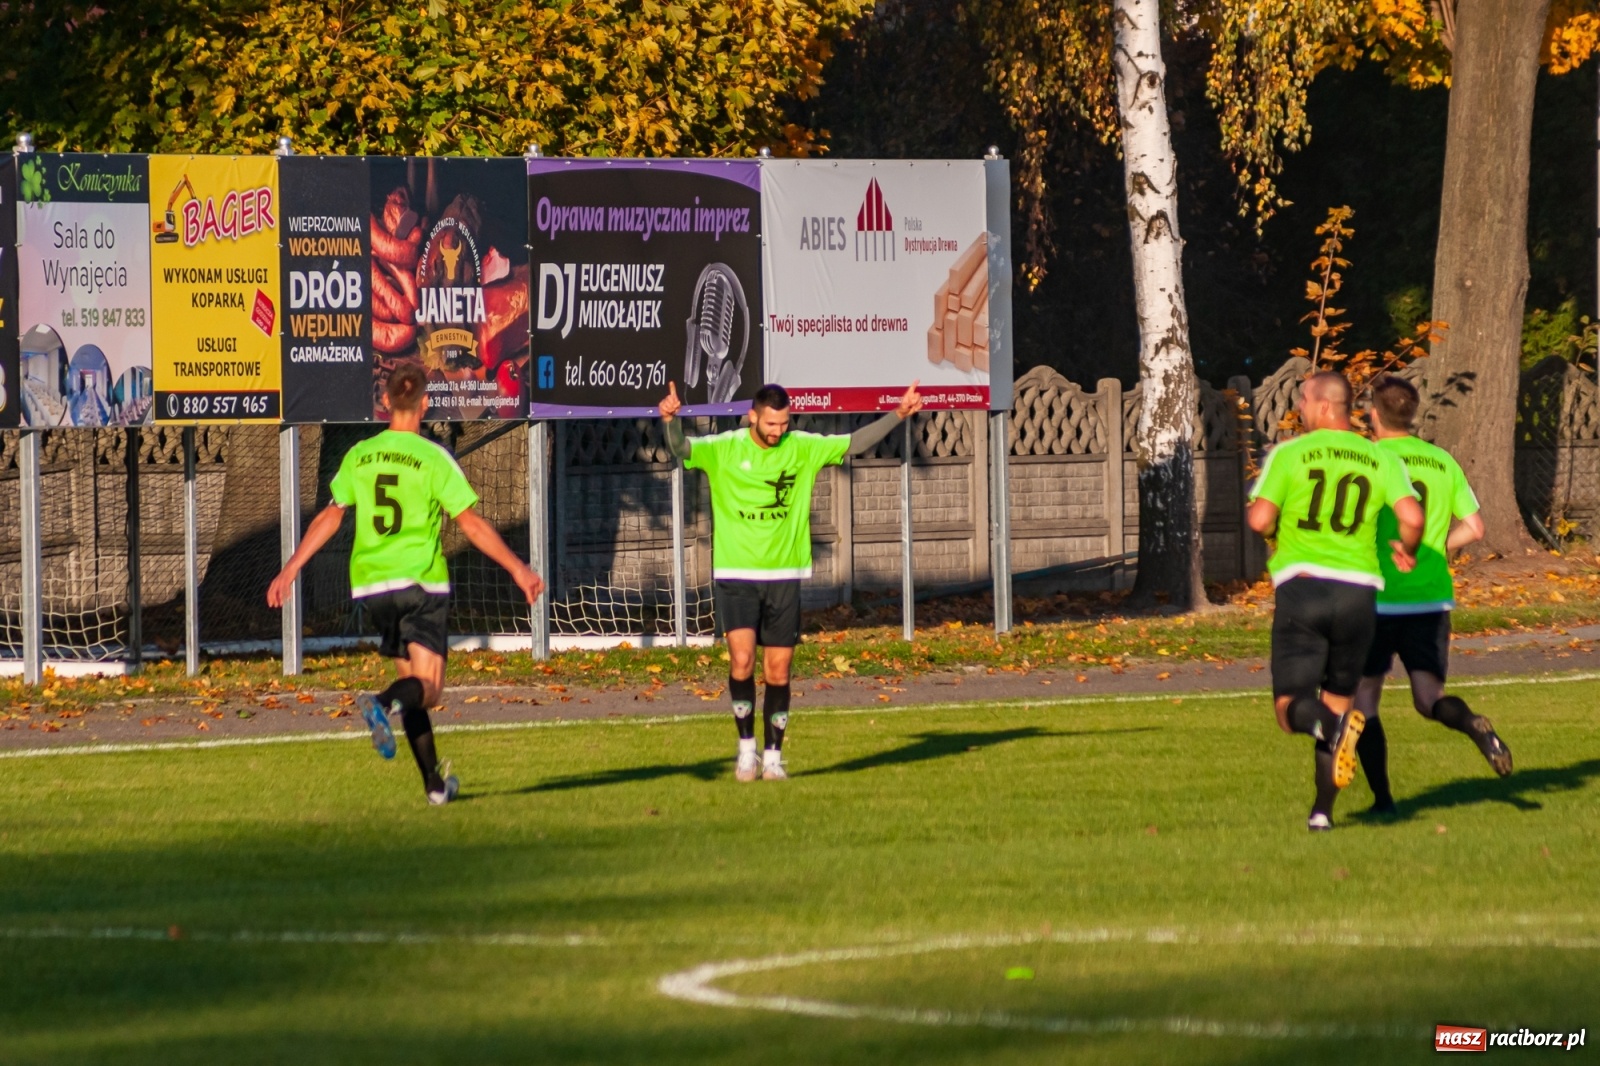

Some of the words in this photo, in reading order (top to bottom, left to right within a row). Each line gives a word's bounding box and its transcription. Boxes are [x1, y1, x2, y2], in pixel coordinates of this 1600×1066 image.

[57, 163, 142, 201] Koniczynka
[182, 186, 275, 247] BAGER
[288, 216, 362, 232] WIEPRZOWINA
[536, 196, 604, 240] Oprawa
[608, 206, 690, 241] muzyczna
[694, 196, 750, 241] imprez
[904, 217, 922, 232] Polska
[53, 221, 89, 249] Sala
[94, 222, 115, 249] do
[800, 216, 847, 251] ABIES
[288, 238, 362, 256] WOŁOWINA
[904, 237, 937, 255] Dystrybucja
[938, 237, 958, 252] Drewna
[43, 259, 127, 294] Wynajęcia
[163, 268, 222, 284] WYKONAM
[226, 267, 268, 284] USŁUGI
[289, 260, 362, 309] DRÓB
[580, 263, 665, 292] EUGENIUSZ
[191, 292, 246, 312] KOPARKĄ
[415, 287, 487, 323] JANETA
[537, 263, 577, 339] DJ
[62, 308, 78, 327] tel.
[81, 308, 99, 327] 519
[102, 308, 122, 327] 847
[125, 308, 145, 327] 833
[578, 300, 662, 332] MIKOŁAJEK
[770, 314, 795, 337] Twój
[797, 315, 852, 337] specjalista
[855, 315, 868, 332] od
[871, 315, 908, 332] drewna
[290, 314, 363, 343] WĘDLINY
[436, 333, 468, 342] ERNESTYN
[197, 337, 237, 353] USŁUGI
[290, 342, 363, 362] GARMAŻERKA
[174, 361, 261, 377] TRANSPORTOWE
[565, 355, 585, 386] tel.
[589, 361, 615, 386] 660
[619, 360, 642, 389] 623
[645, 360, 666, 390] 761
[183, 396, 208, 414] 880
[212, 396, 237, 414] 557
[242, 396, 268, 414] 965
[376, 451, 422, 470] TWORKÓW
[1303, 449, 1323, 464] LKS
[1327, 447, 1380, 471] TWORKÓW
[1402, 455, 1447, 473] WORKÓW
[373, 474, 403, 536] 5
[1297, 469, 1371, 535] 10
